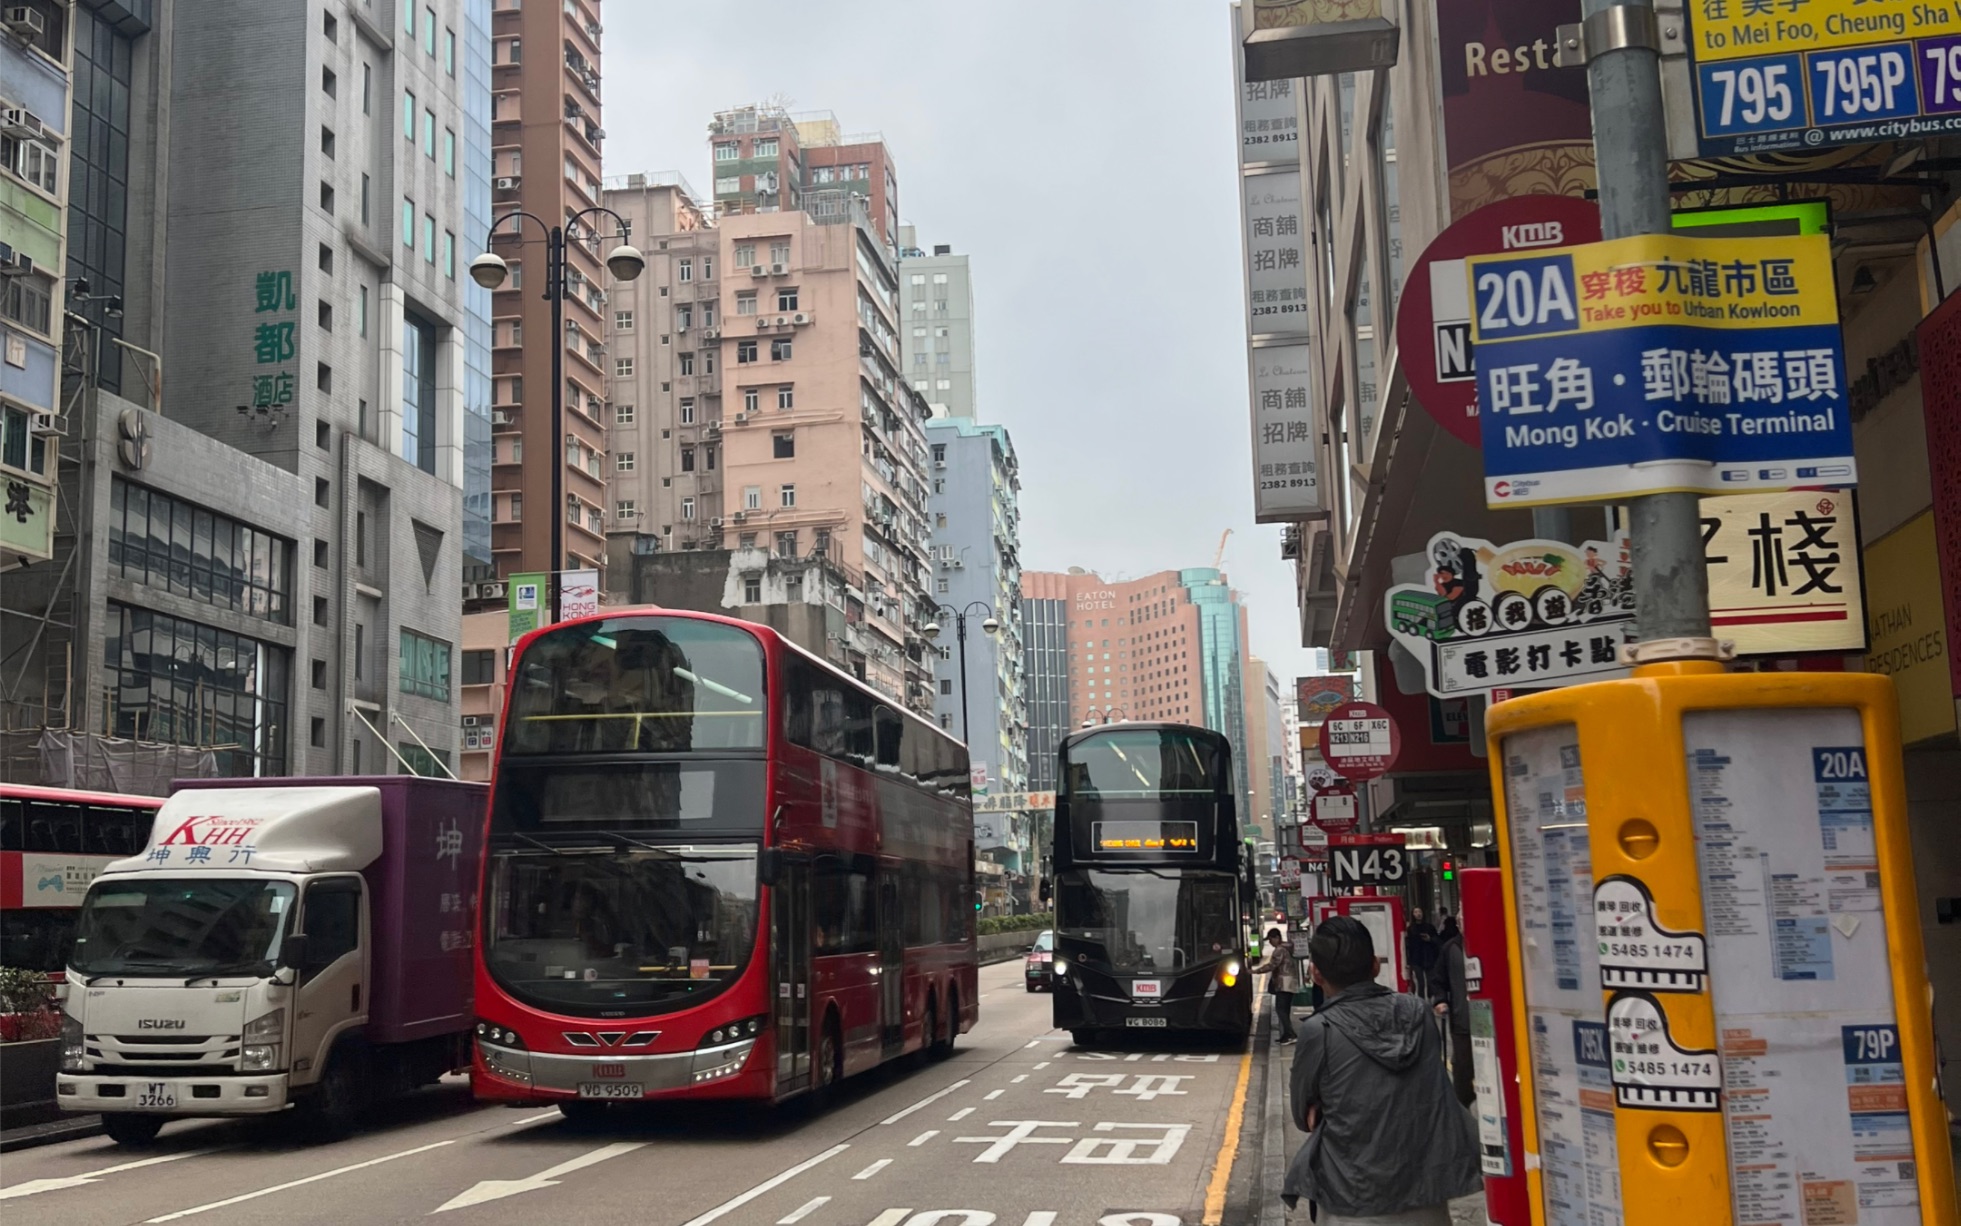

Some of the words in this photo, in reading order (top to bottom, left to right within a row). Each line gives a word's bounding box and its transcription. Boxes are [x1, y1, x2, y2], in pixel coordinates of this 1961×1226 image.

[1705, 29, 1726, 49] to
[1733, 22, 1770, 46] Mei
[1776, 20, 1819, 42] Foo,
[1825, 12, 1905, 35] Cheung
[1912, 4, 1949, 26] Sha
[1711, 63, 1793, 127] 795
[1815, 51, 1906, 117] 795P
[1244, 116, 1298, 133] 租務查詢
[1244, 136, 1270, 145] 2382
[1272, 132, 1298, 143] 8913
[1501, 221, 1564, 250] KMB
[1253, 247, 1300, 271] 招牌
[1580, 266, 1648, 301] 穿梭
[1655, 256, 1800, 298] 九龍市區
[1251, 287, 1306, 303] 租務查詢
[1477, 264, 1577, 331] 20A
[254, 270, 296, 364] 凱都
[1252, 306, 1278, 316] 2382
[1281, 303, 1308, 314] 8913
[1582, 303, 1626, 323] Take
[1630, 301, 1662, 321] you
[1665, 301, 1682, 317] to
[1683, 301, 1725, 320] Urban
[1729, 303, 1801, 319] Kowloon
[252, 371, 294, 407] 酒店
[1262, 421, 1309, 444] 招牌
[1505, 424, 1579, 449] Mong
[1585, 413, 1635, 440] Kok
[1656, 409, 1722, 435] Cruise
[1725, 408, 1835, 436] Terminal
[1260, 460, 1316, 477] 租務查詢
[1261, 480, 1287, 490] 2382
[1290, 477, 1317, 488] 8913
[1076, 590, 1116, 602] EATON
[563, 602, 596, 611] HONG
[1076, 600, 1116, 611] HOTEL
[1463, 635, 1617, 679] 電影打卡點
[1332, 721, 1343, 731] 6C
[1353, 721, 1364, 731] 6F
[1371, 720, 1387, 730] X6C
[1330, 733, 1349, 744] N213
[1350, 732, 1369, 743] N216
[1820, 751, 1866, 779] 20A
[158, 815, 255, 846] KHH
[145, 845, 257, 866] 坤興行
[1308, 862, 1329, 872] N41
[1333, 848, 1404, 882] N43
[1611, 943, 1648, 957] 5485
[1652, 945, 1694, 958] 1474
[1136, 983, 1157, 993] KMB
[138, 1019, 186, 1029] ISUZU
[1578, 1027, 1608, 1063] 795X
[1854, 1028, 1895, 1060] 79P
[1627, 1060, 1666, 1076] 5485
[1670, 1062, 1712, 1076] 1474
[148, 1083, 165, 1094] WT
[584, 1084, 601, 1096] VD
[605, 1084, 640, 1097] 9509
[138, 1094, 175, 1106] 3266
